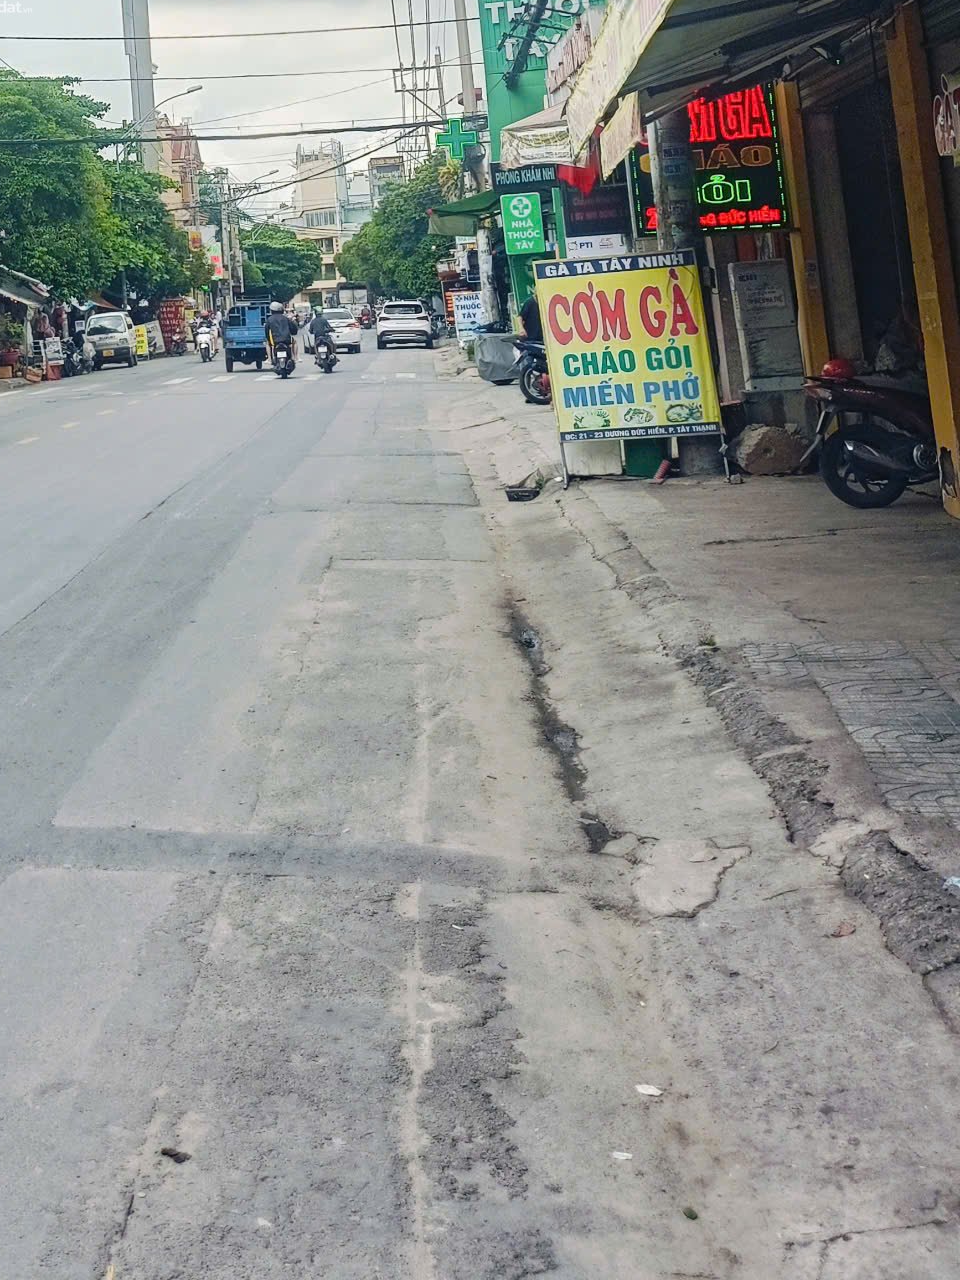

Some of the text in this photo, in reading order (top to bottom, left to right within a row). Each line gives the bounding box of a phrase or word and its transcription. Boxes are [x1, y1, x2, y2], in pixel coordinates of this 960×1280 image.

[697, 174, 751, 204] ỎI
[507, 228, 540, 239] THUỐC
[512, 219, 533, 228] NHÀ
[579, 241, 593, 249] PTI
[545, 254, 684, 277] GÀ TA TÂY NINH
[548, 268, 699, 345] CƠM GÀ
[562, 338, 692, 377] CHÁO GỎI
[562, 371, 701, 409] MIẾN PHỞ
